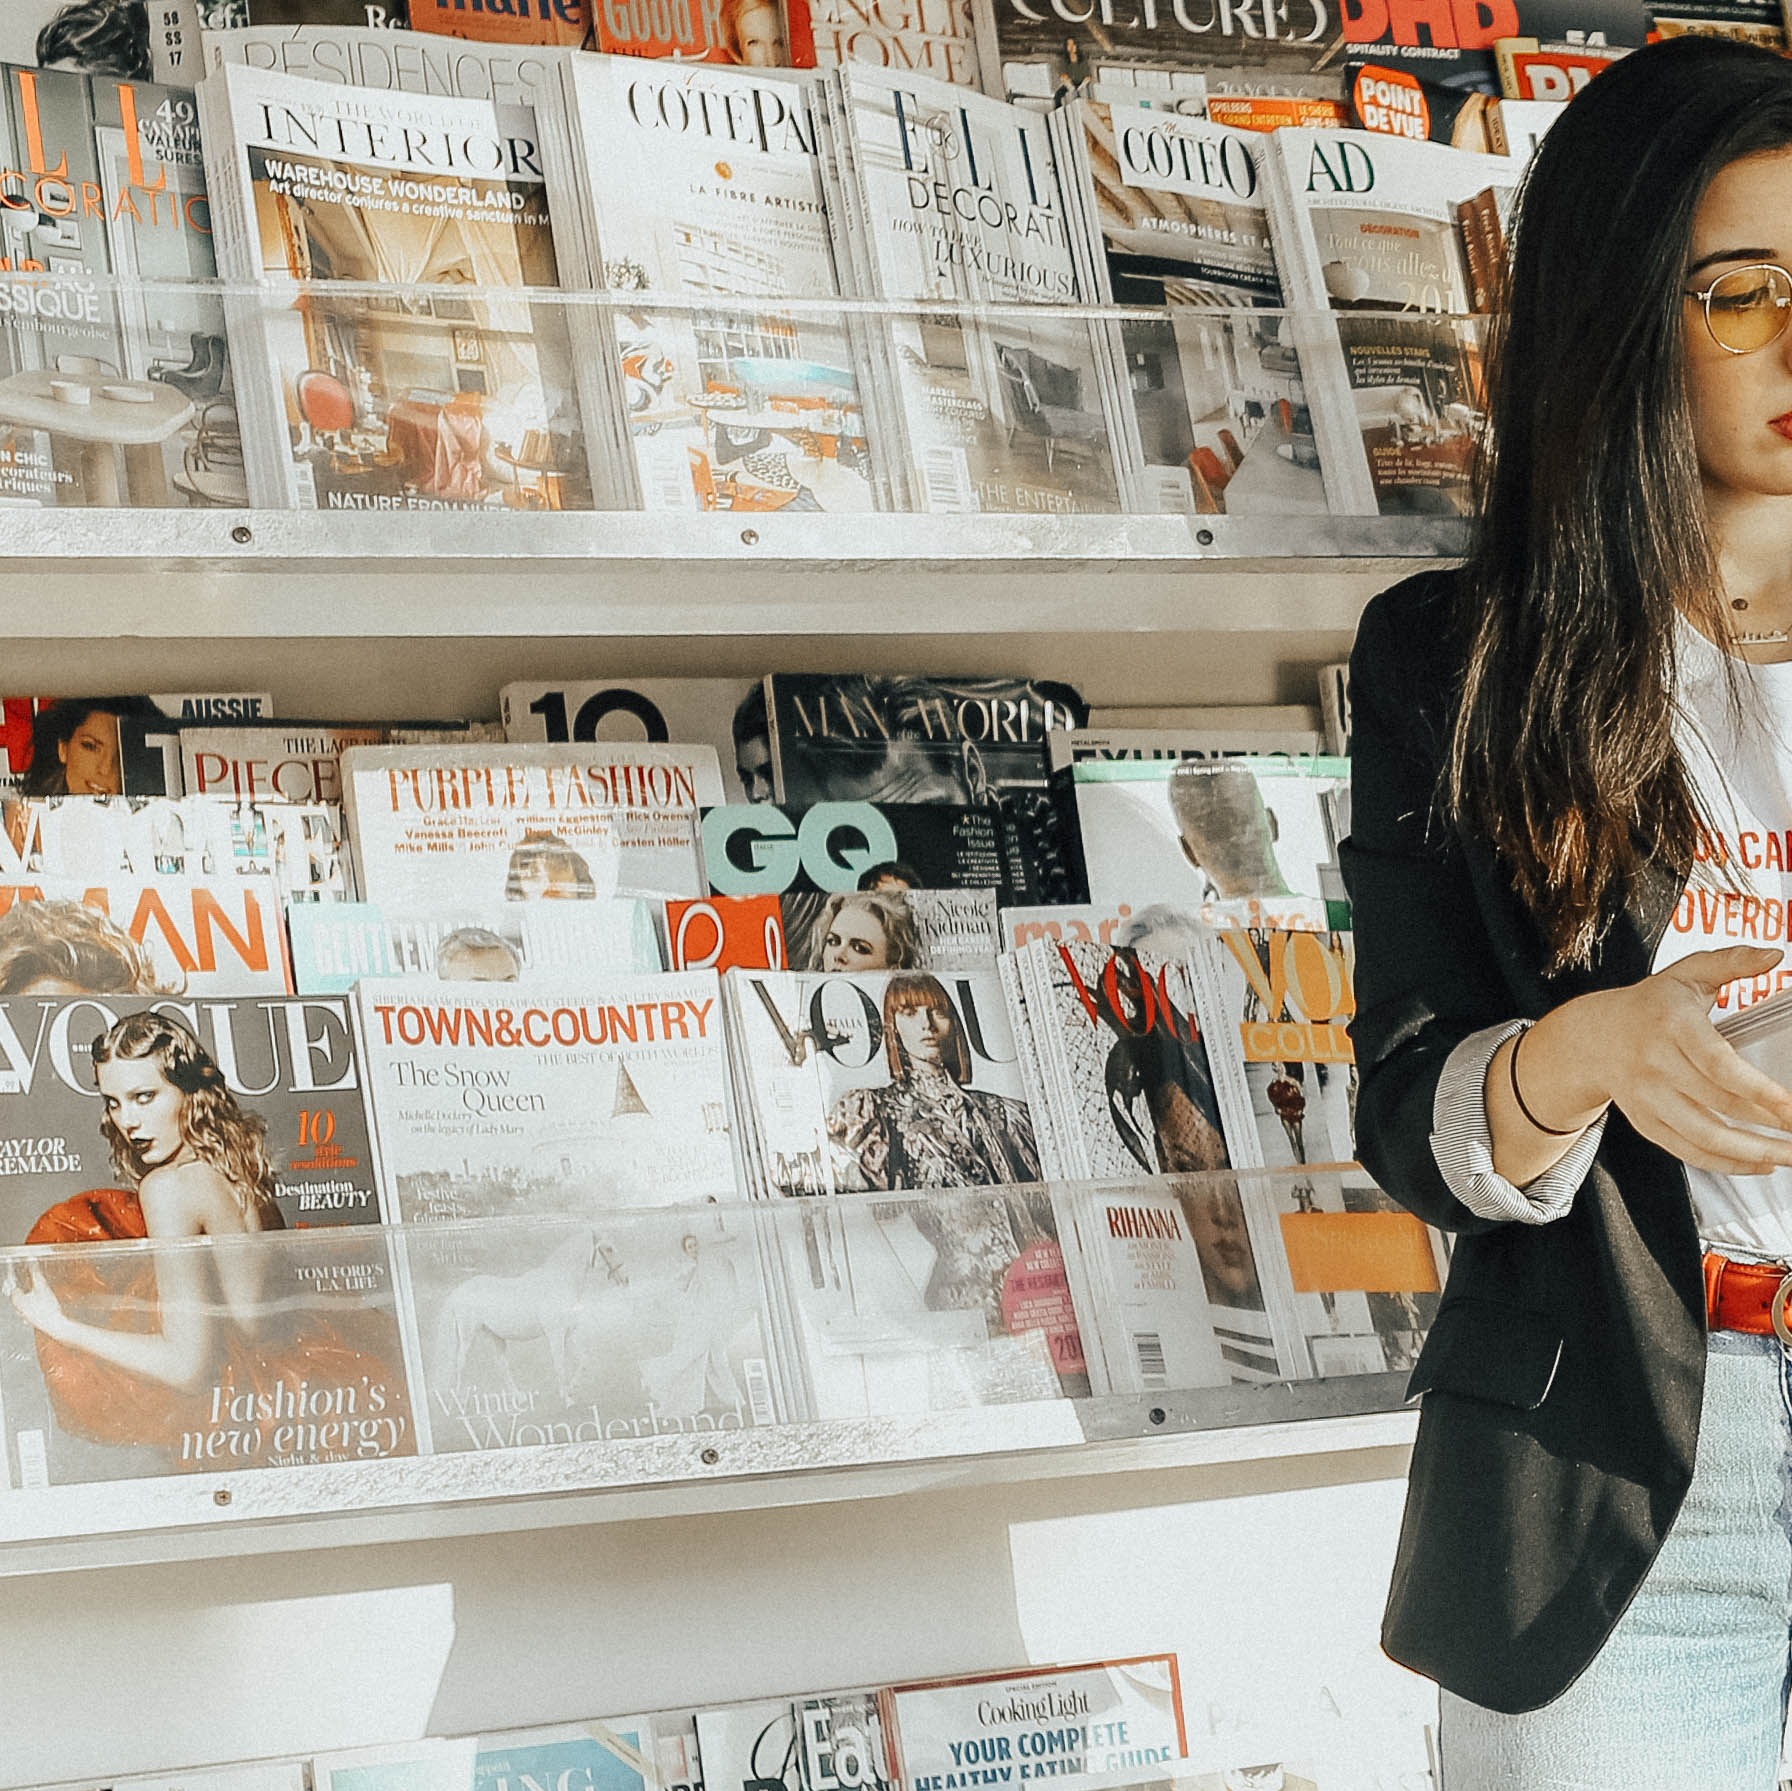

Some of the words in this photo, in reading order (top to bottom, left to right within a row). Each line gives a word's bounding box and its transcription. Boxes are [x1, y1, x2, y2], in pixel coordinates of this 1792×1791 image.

[1401, 47, 1460, 59] CONTRACT
[1359, 78, 1422, 114] POINT
[156, 99, 194, 126] 49
[1364, 108, 1391, 132] DE
[1386, 112, 1426, 141] VUE
[261, 104, 545, 177] INTERIOR
[1305, 140, 1374, 193] AD
[265, 159, 385, 195] WAREHOUSE
[387, 180, 525, 210] WONDERLAND
[690, 184, 706, 195] LA
[715, 188, 756, 203] FIBRE
[269, 180, 291, 193] Art
[292, 184, 342, 203] director
[344, 192, 399, 212] conjures
[402, 201, 409, 212] a
[412, 201, 463, 220] creative
[466, 210, 522, 225] sanctum
[524, 212, 537, 224] in
[893, 219, 923, 234] HOW
[1243, 233, 1256, 245] ET
[1350, 347, 1401, 355] NOUVELLES
[1403, 347, 1430, 358] STARS
[182, 699, 262, 719] AUSSIE
[529, 688, 668, 742] 10
[918, 698, 1073, 742] WORLD
[387, 765, 530, 812] PURPLE
[544, 765, 696, 808] FASHION
[557, 826, 608, 836] McGinley
[626, 812, 650, 821] Rick
[653, 812, 689, 822] Owens
[971, 816, 991, 825] The
[406, 829, 454, 839] Vanessa
[953, 826, 994, 837] Fashion
[968, 838, 995, 848] Issue
[394, 842, 422, 853] Mike
[427, 843, 454, 852] Mills
[703, 801, 897, 893] GQ
[938, 902, 988, 919] Nicole
[923, 917, 993, 936] Kidman
[375, 998, 714, 1047] TOWN&COUNTRY
[0, 998, 358, 1096] VOUE
[391, 1061, 440, 1087] The
[445, 1063, 510, 1088] Snow
[463, 1089, 546, 1118] Queen
[298, 1110, 335, 1145] 10
[275, 1181, 353, 1198] Destination
[299, 1189, 372, 1211] BEAUTY
[1106, 1207, 1182, 1240] RIHANNA
[296, 1267, 323, 1280] TOM
[328, 1264, 384, 1280] FORD'S
[346, 1275, 377, 1290] LIFE
[211, 1375, 387, 1423] Fashion's
[435, 1387, 539, 1416] Winter
[183, 1431, 261, 1460] new
[272, 1416, 405, 1460] energy
[457, 1401, 745, 1448] Wonderland
[978, 1700, 1047, 1728] Cooking
[1048, 1691, 1090, 1720] Light
[949, 1738, 1011, 1766] YOUR
[1019, 1722, 1128, 1754] COMPLETE
